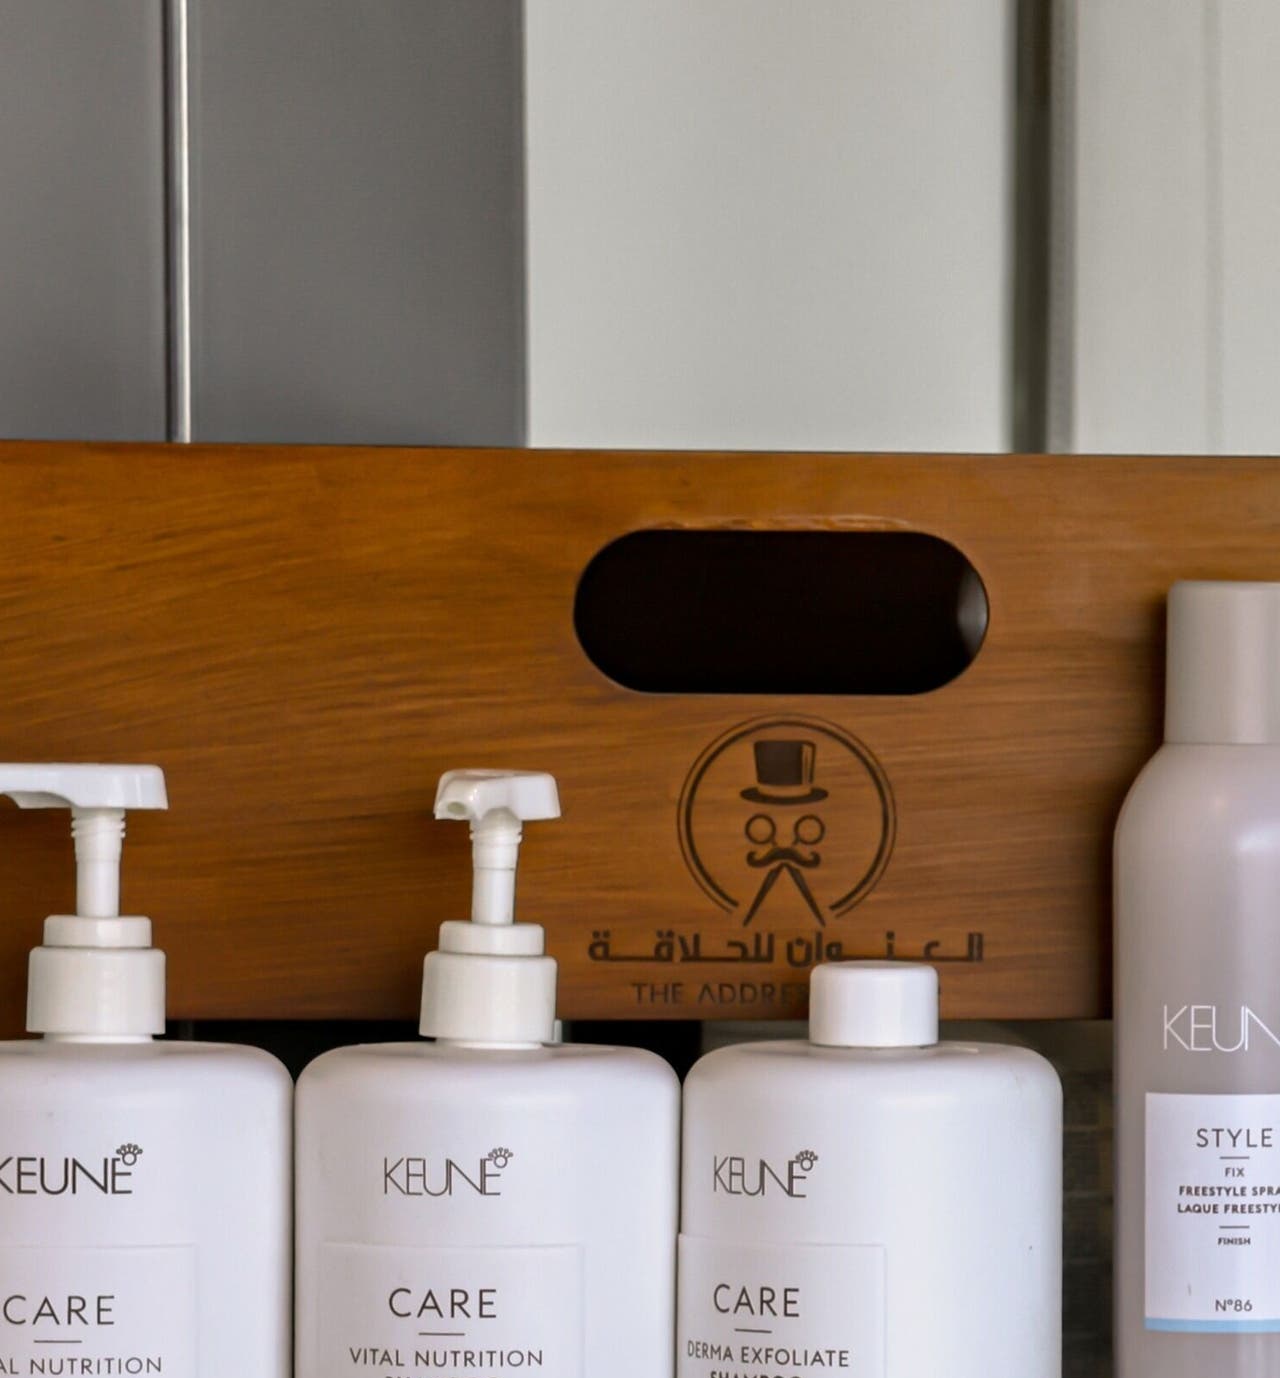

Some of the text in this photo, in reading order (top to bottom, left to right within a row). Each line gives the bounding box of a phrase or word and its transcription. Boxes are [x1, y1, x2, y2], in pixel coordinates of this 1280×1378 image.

[633, 983, 683, 1003] THE
[1196, 1128, 1273, 1148] STYLE
[384, 1157, 501, 1196] KEUNE
[713, 1155, 806, 1198] KEUNE
[1225, 1167, 1245, 1177] FIX
[1179, 1186, 1247, 1196] FREESTYLE
[1177, 1203, 1219, 1214] LAQUE
[1217, 1237, 1251, 1245] FINISH
[3, 1294, 115, 1325] CARE
[388, 1287, 497, 1318] CARE
[713, 1283, 799, 1318] CARE
[349, 1347, 543, 1368] VITAL NUTRITION
[687, 1339, 849, 1367] DERMA EXFOLIATE
[30, 1356, 162, 1376] NUTRITION
